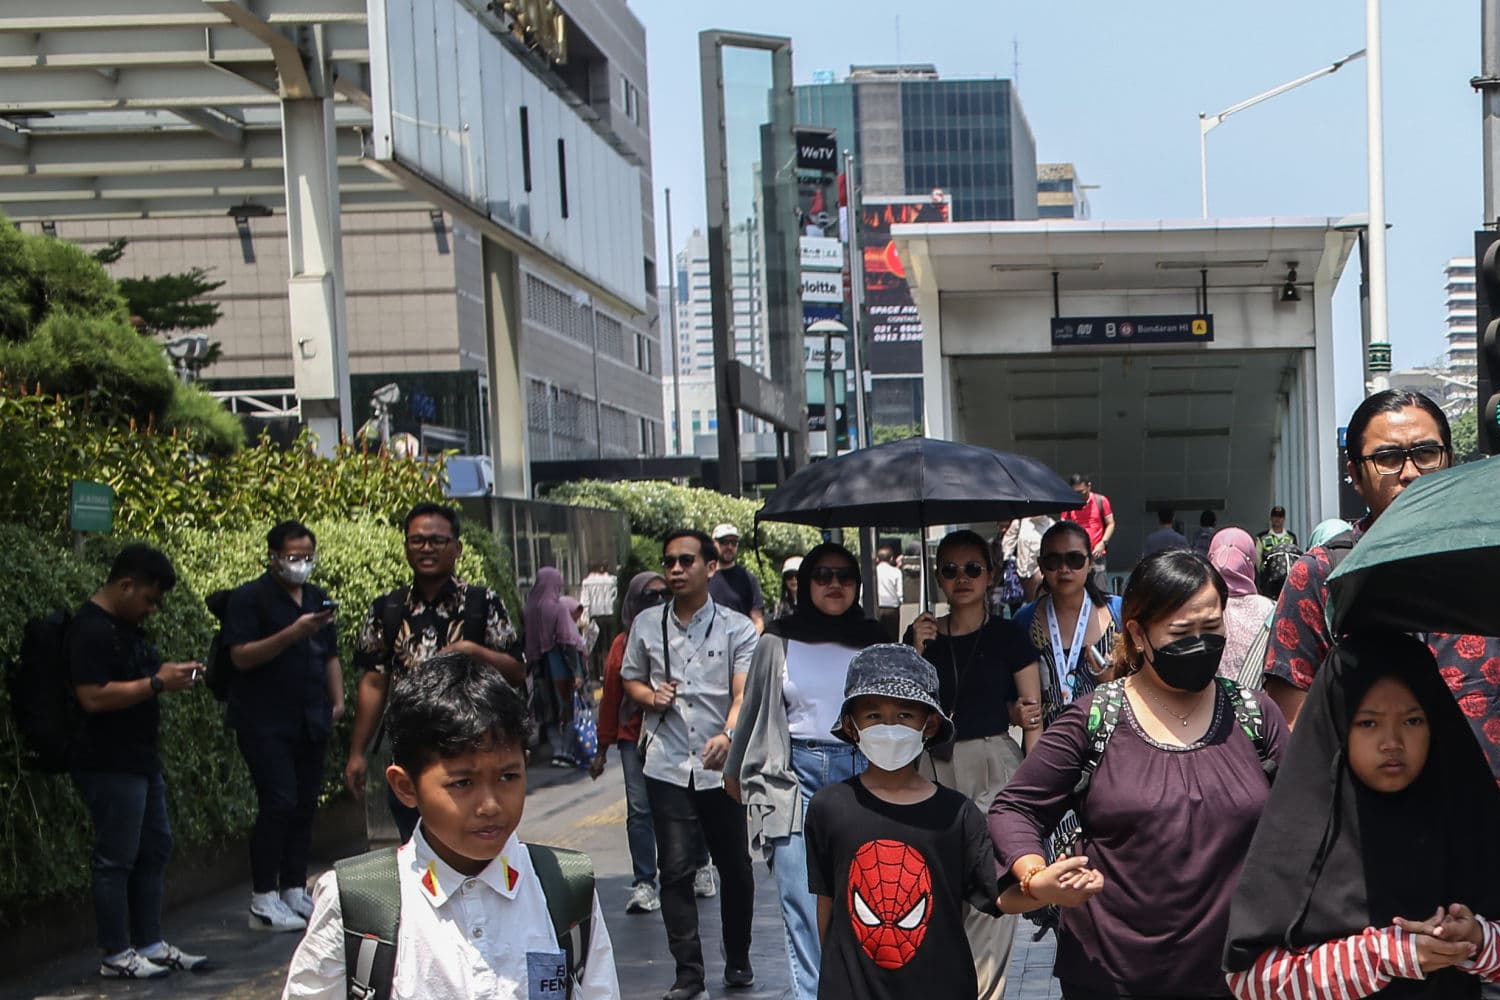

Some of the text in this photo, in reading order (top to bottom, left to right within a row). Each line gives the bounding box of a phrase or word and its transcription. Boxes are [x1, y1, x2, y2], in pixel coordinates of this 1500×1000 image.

[801, 146, 834, 160] WeTV
[869, 305, 901, 315] SPACE
[1137, 325, 1177, 333] Bundaran
